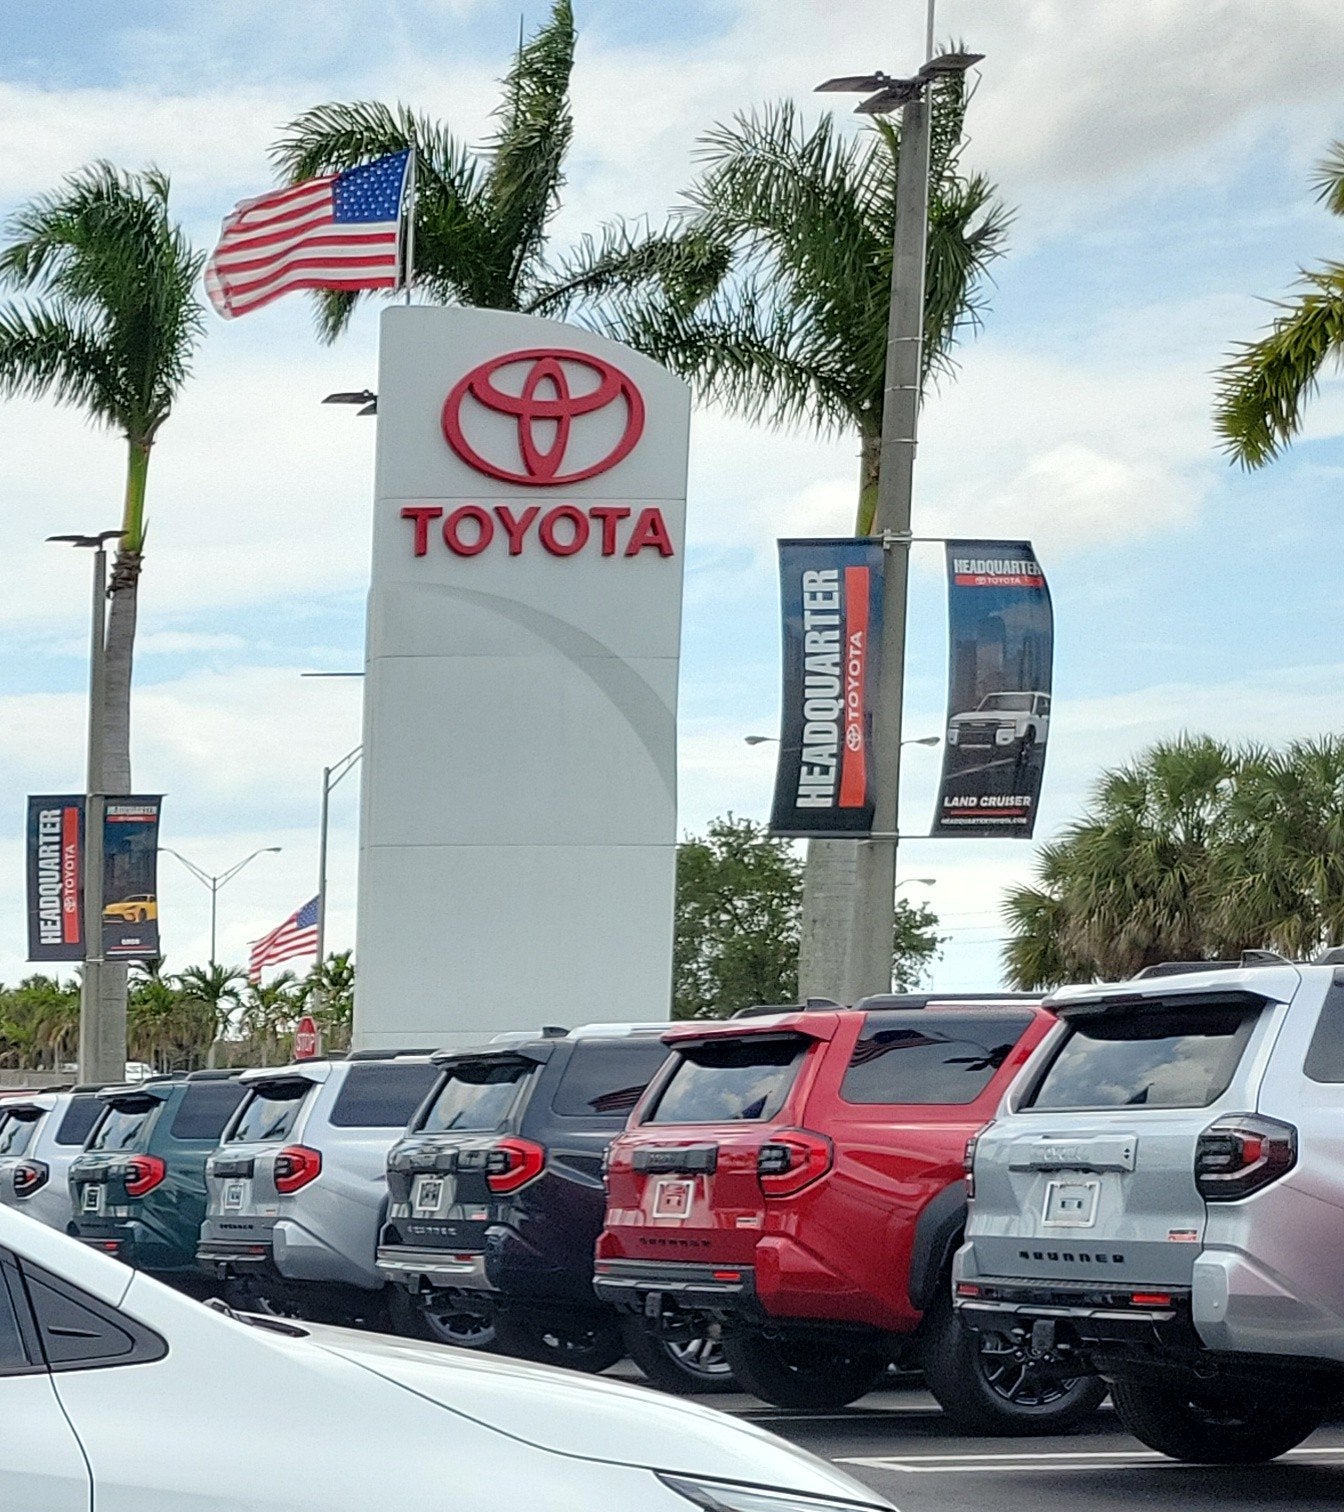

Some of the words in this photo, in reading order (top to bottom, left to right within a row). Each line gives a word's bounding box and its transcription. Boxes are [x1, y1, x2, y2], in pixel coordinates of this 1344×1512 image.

[401, 504, 674, 557] TOYOTA
[954, 558, 1042, 577] HEADQUARTER
[988, 577, 1021, 585] TOYOTA
[796, 568, 845, 809] HEADQUARTER
[848, 631, 863, 719] TOYOTA
[944, 796, 977, 807] LAND
[980, 795, 1031, 807] CRUISER
[39, 809, 63, 944] HEADQUARTER
[64, 844, 76, 895] TOYOTA
